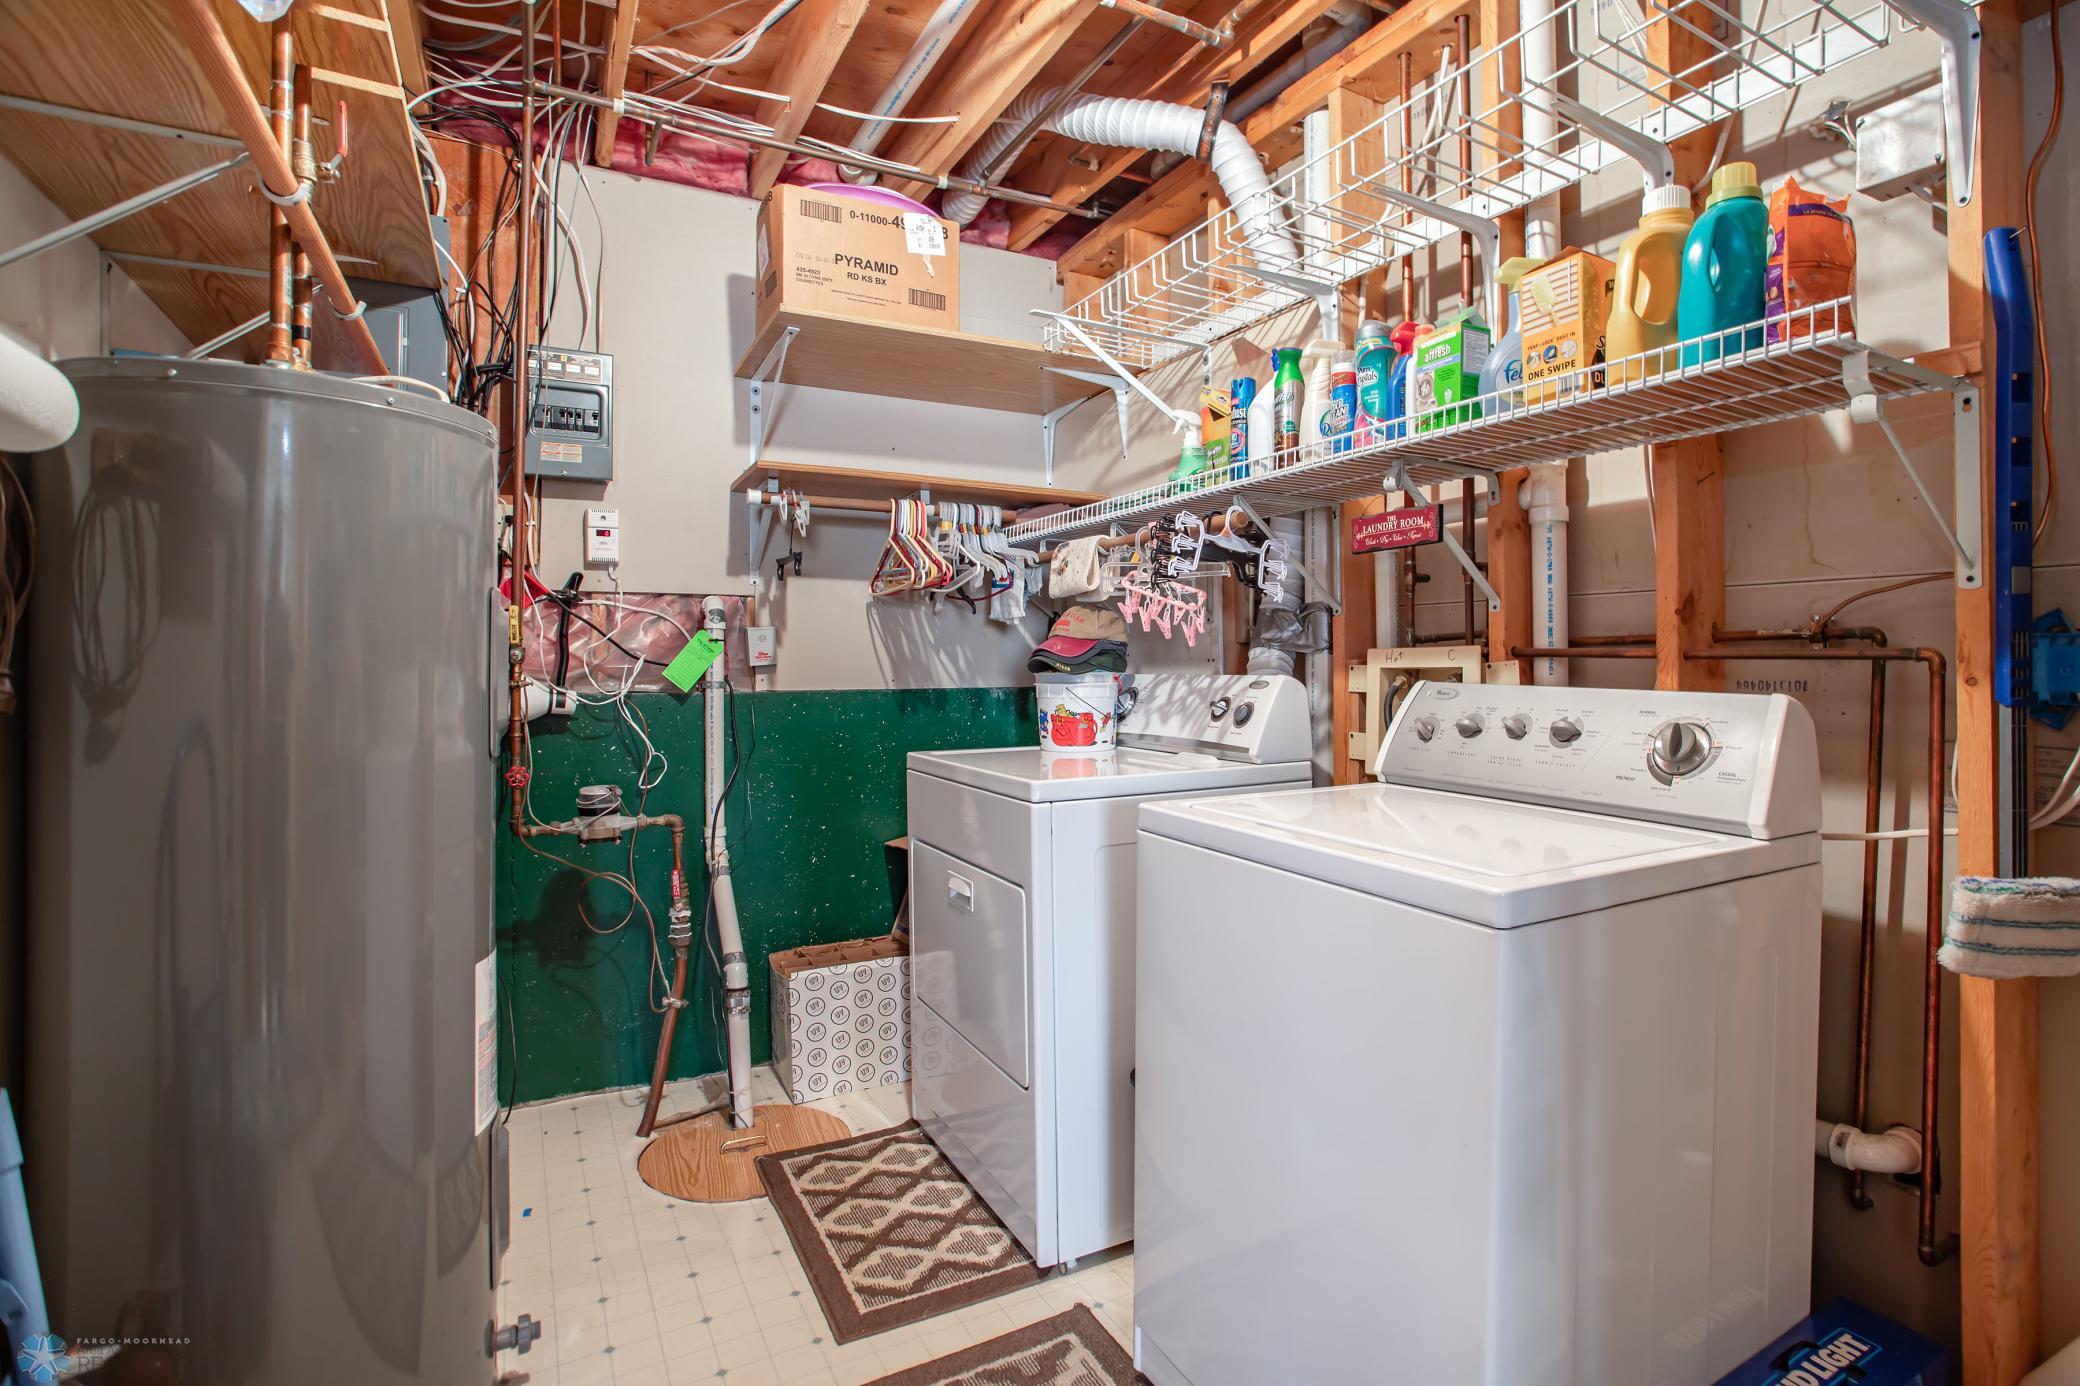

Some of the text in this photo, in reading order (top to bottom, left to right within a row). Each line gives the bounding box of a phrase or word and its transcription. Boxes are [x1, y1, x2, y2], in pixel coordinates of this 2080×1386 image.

[834, 253, 899, 276] PYRAMID
[847, 272, 887, 286] RD KS BX
[1424, 344, 1451, 362] affresh
[1528, 359, 1576, 381] ONE SWIPE
[1363, 516, 1424, 534] LAUNDRY ROOM
[1386, 514, 1397, 522] THE
[1385, 649, 1403, 664] Hot
[1801, 1333, 1870, 1380] LIGHT
